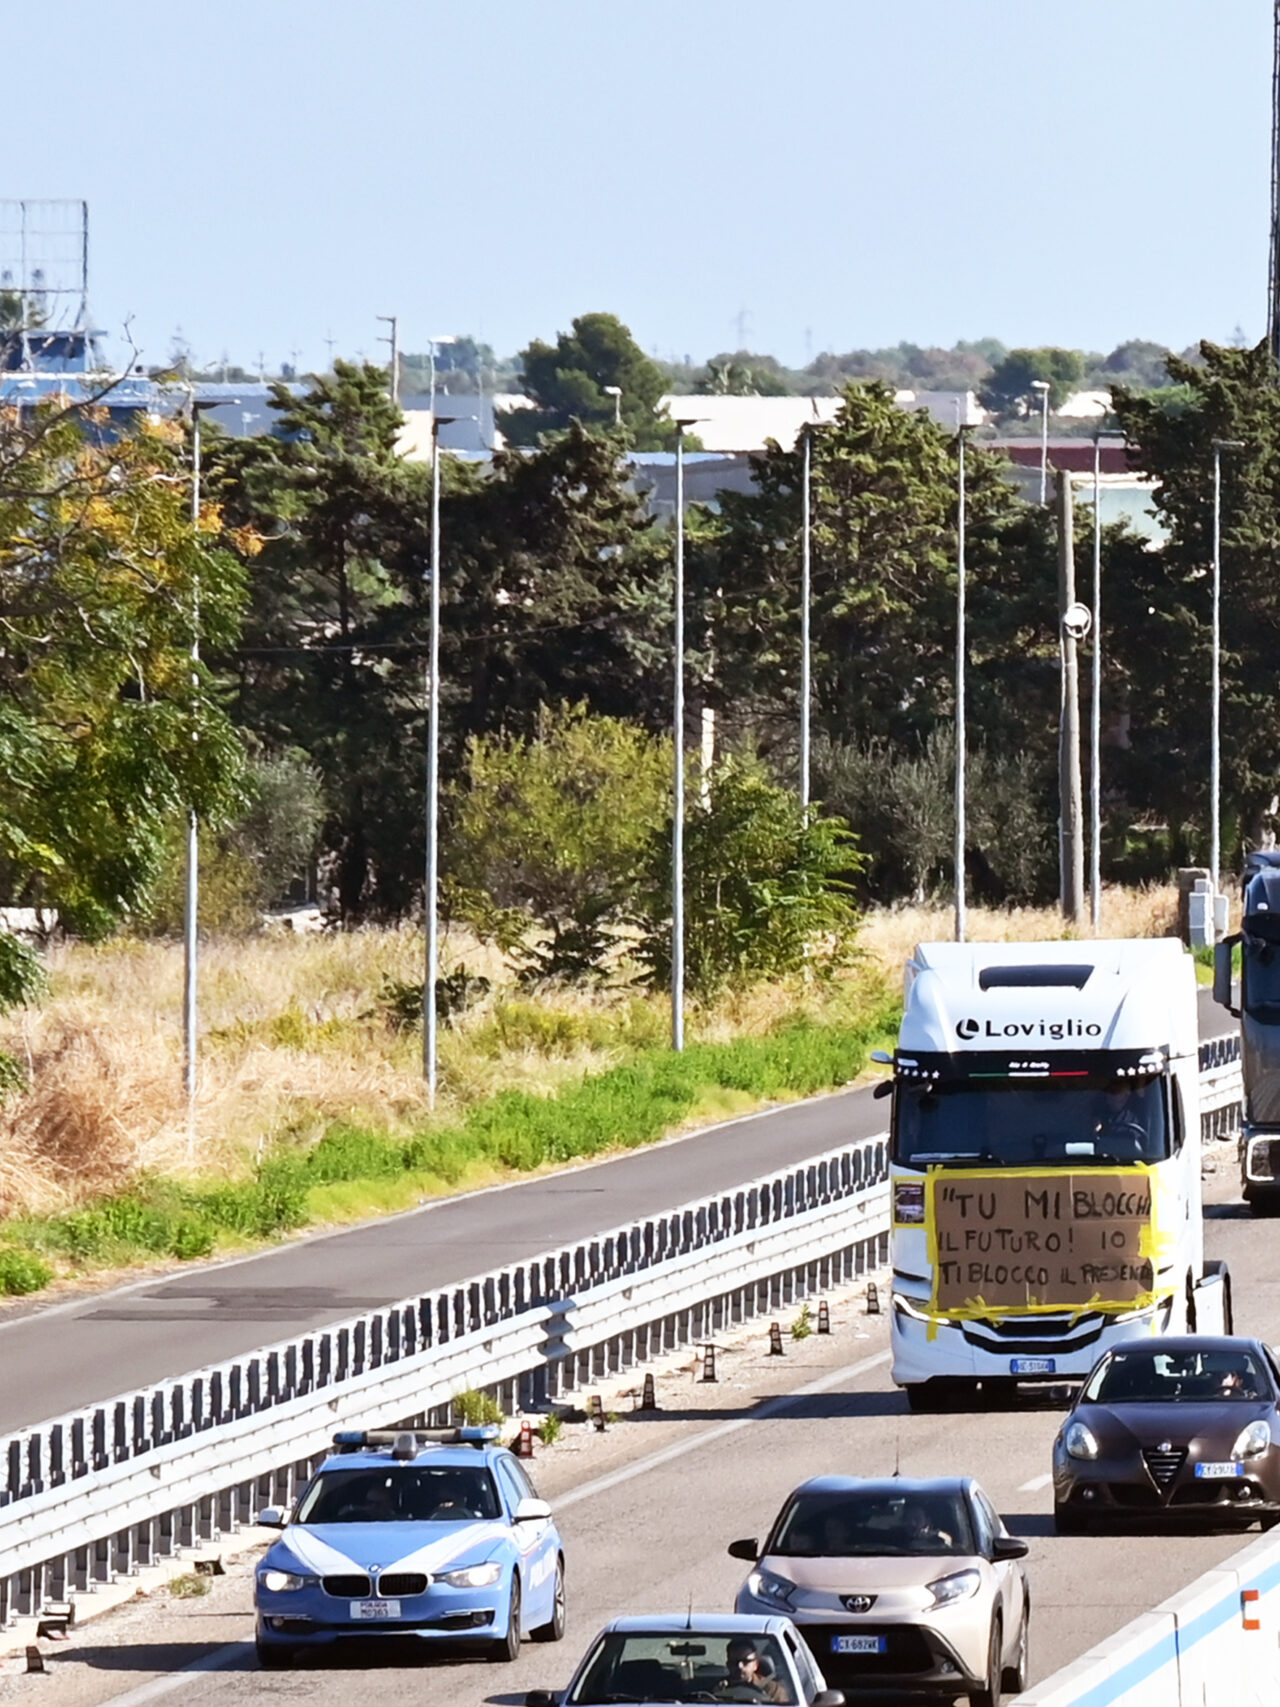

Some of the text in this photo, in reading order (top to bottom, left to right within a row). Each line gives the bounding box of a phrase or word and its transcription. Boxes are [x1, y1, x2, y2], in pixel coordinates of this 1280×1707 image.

[986, 1019, 1101, 1040] Loviglio
[1024, 1189, 1061, 1219] MI
[965, 1227, 1073, 1253] FUTURO!
[1101, 1231, 1126, 1249] IO
[968, 1262, 1049, 1286] BLOCCO
